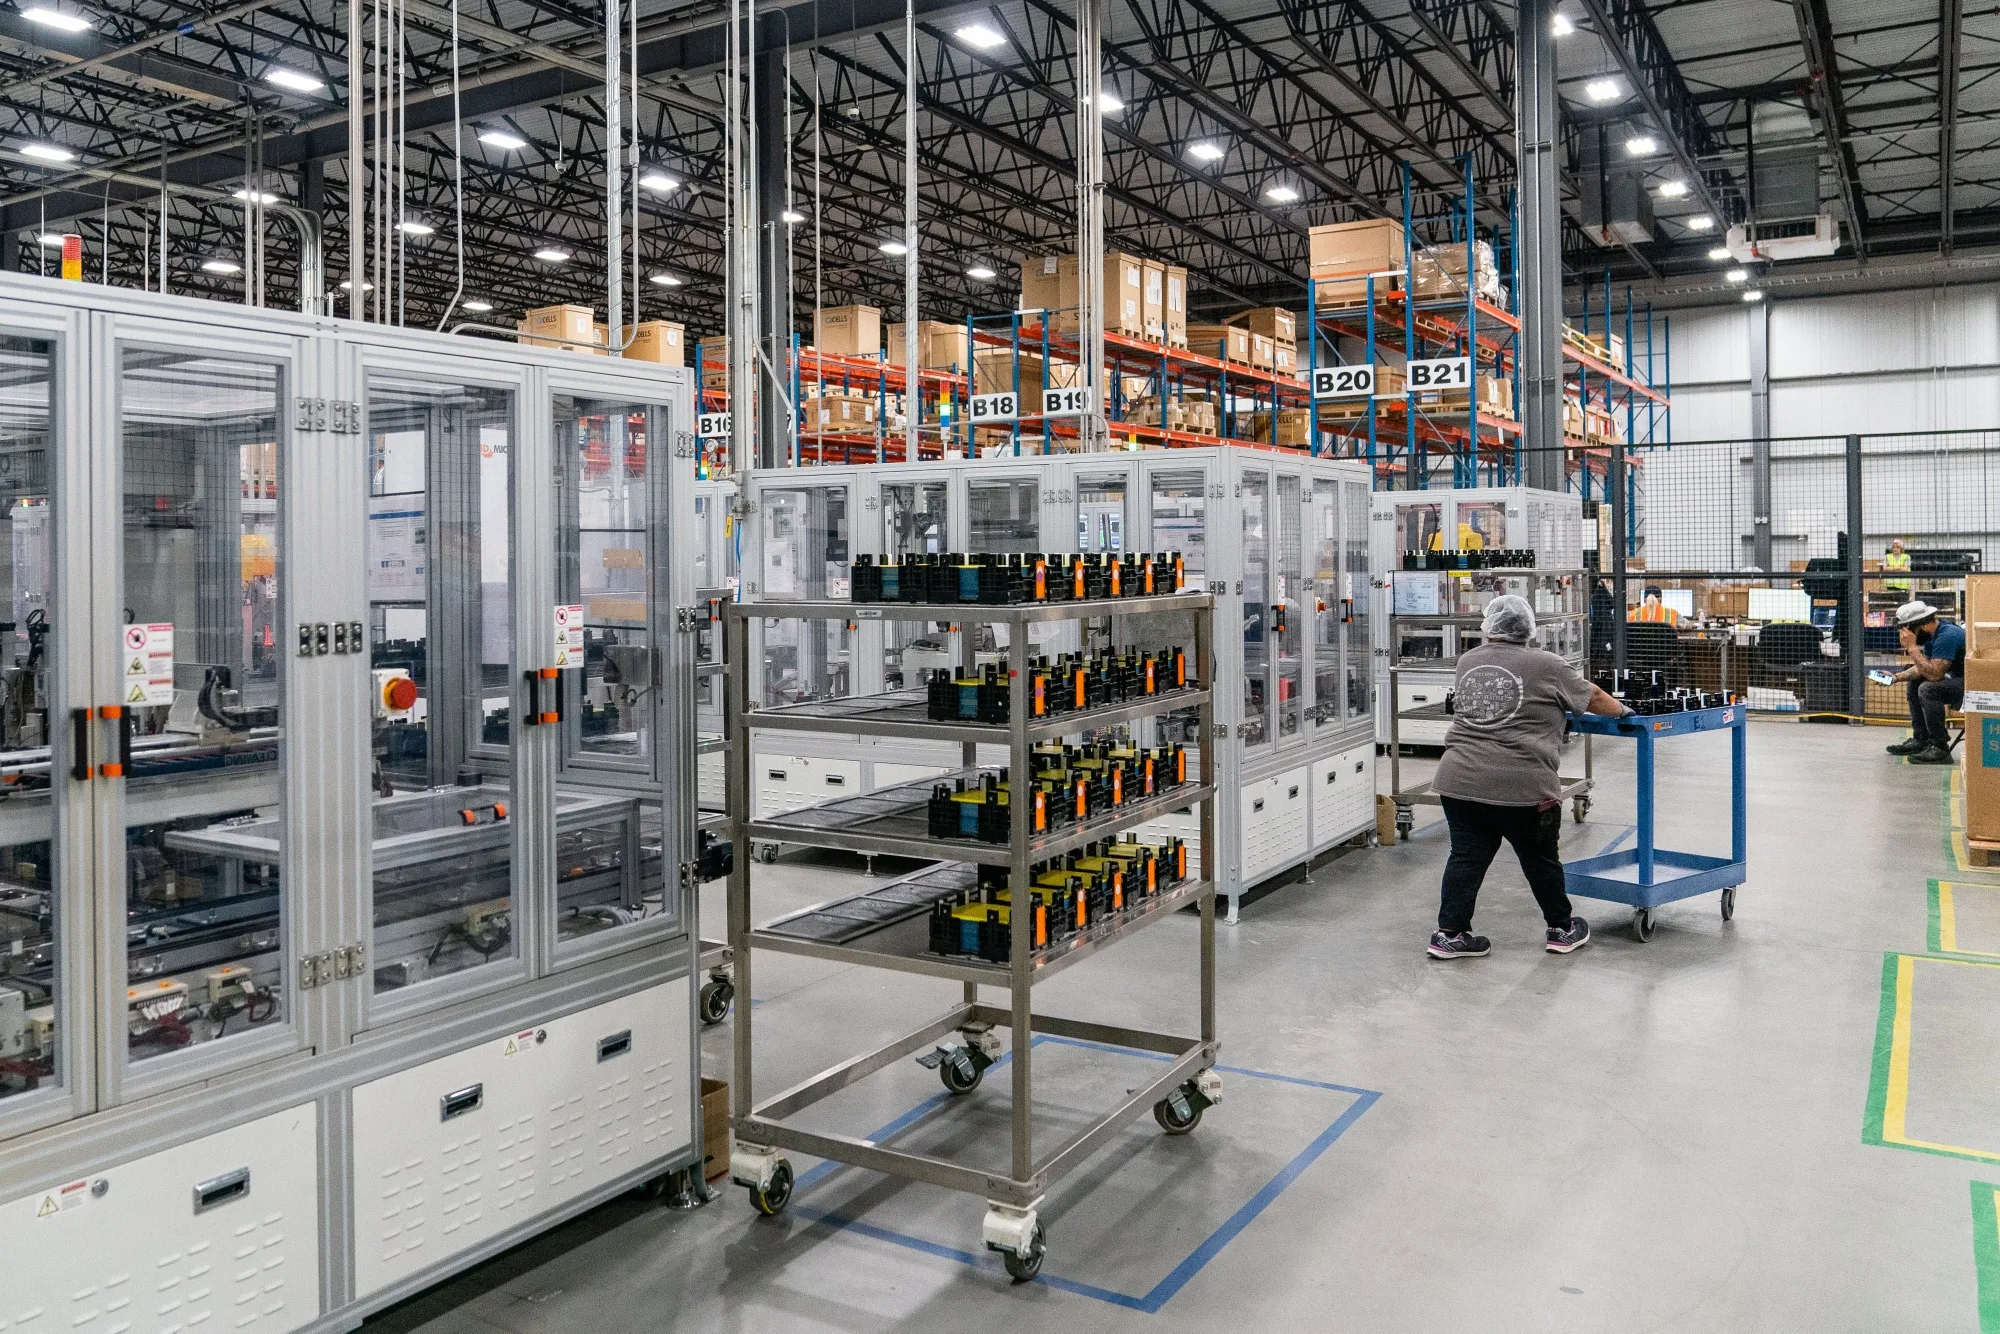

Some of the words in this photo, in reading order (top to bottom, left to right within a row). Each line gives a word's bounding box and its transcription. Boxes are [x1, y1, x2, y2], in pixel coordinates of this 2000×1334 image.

[1316, 370, 1371, 393] B20
[1411, 362, 1466, 386] B21
[973, 396, 1014, 417] B18
